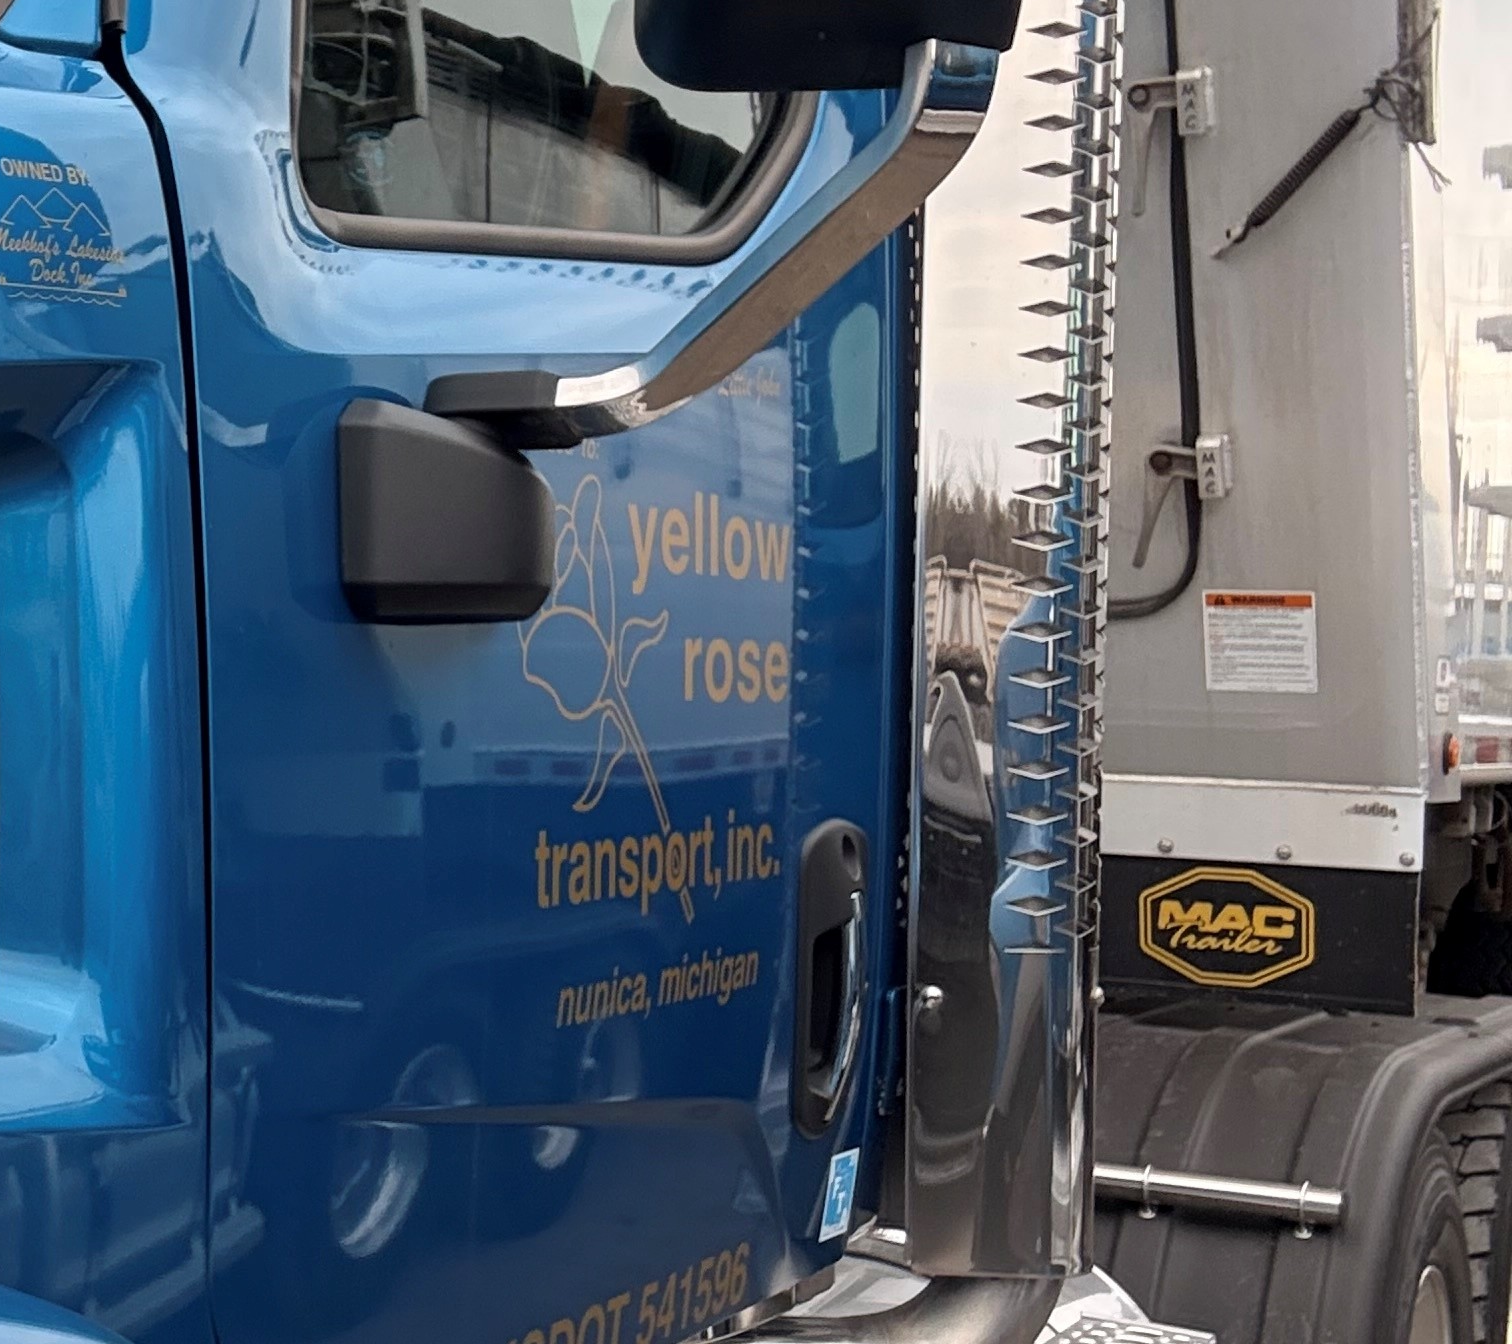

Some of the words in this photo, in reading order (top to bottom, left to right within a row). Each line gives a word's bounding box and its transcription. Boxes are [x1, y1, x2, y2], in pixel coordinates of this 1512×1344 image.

[0, 157, 63, 183] OWNED
[1202, 452, 1216, 494] MAC
[628, 491, 788, 595] yellow
[684, 637, 788, 703] rose
[535, 818, 721, 917] transport,
[727, 808, 780, 882] inc.
[1158, 899, 1296, 939] MAC
[1166, 921, 1283, 956] Trailer
[556, 966, 651, 1029] nunica,
[657, 946, 759, 1006] michigan
